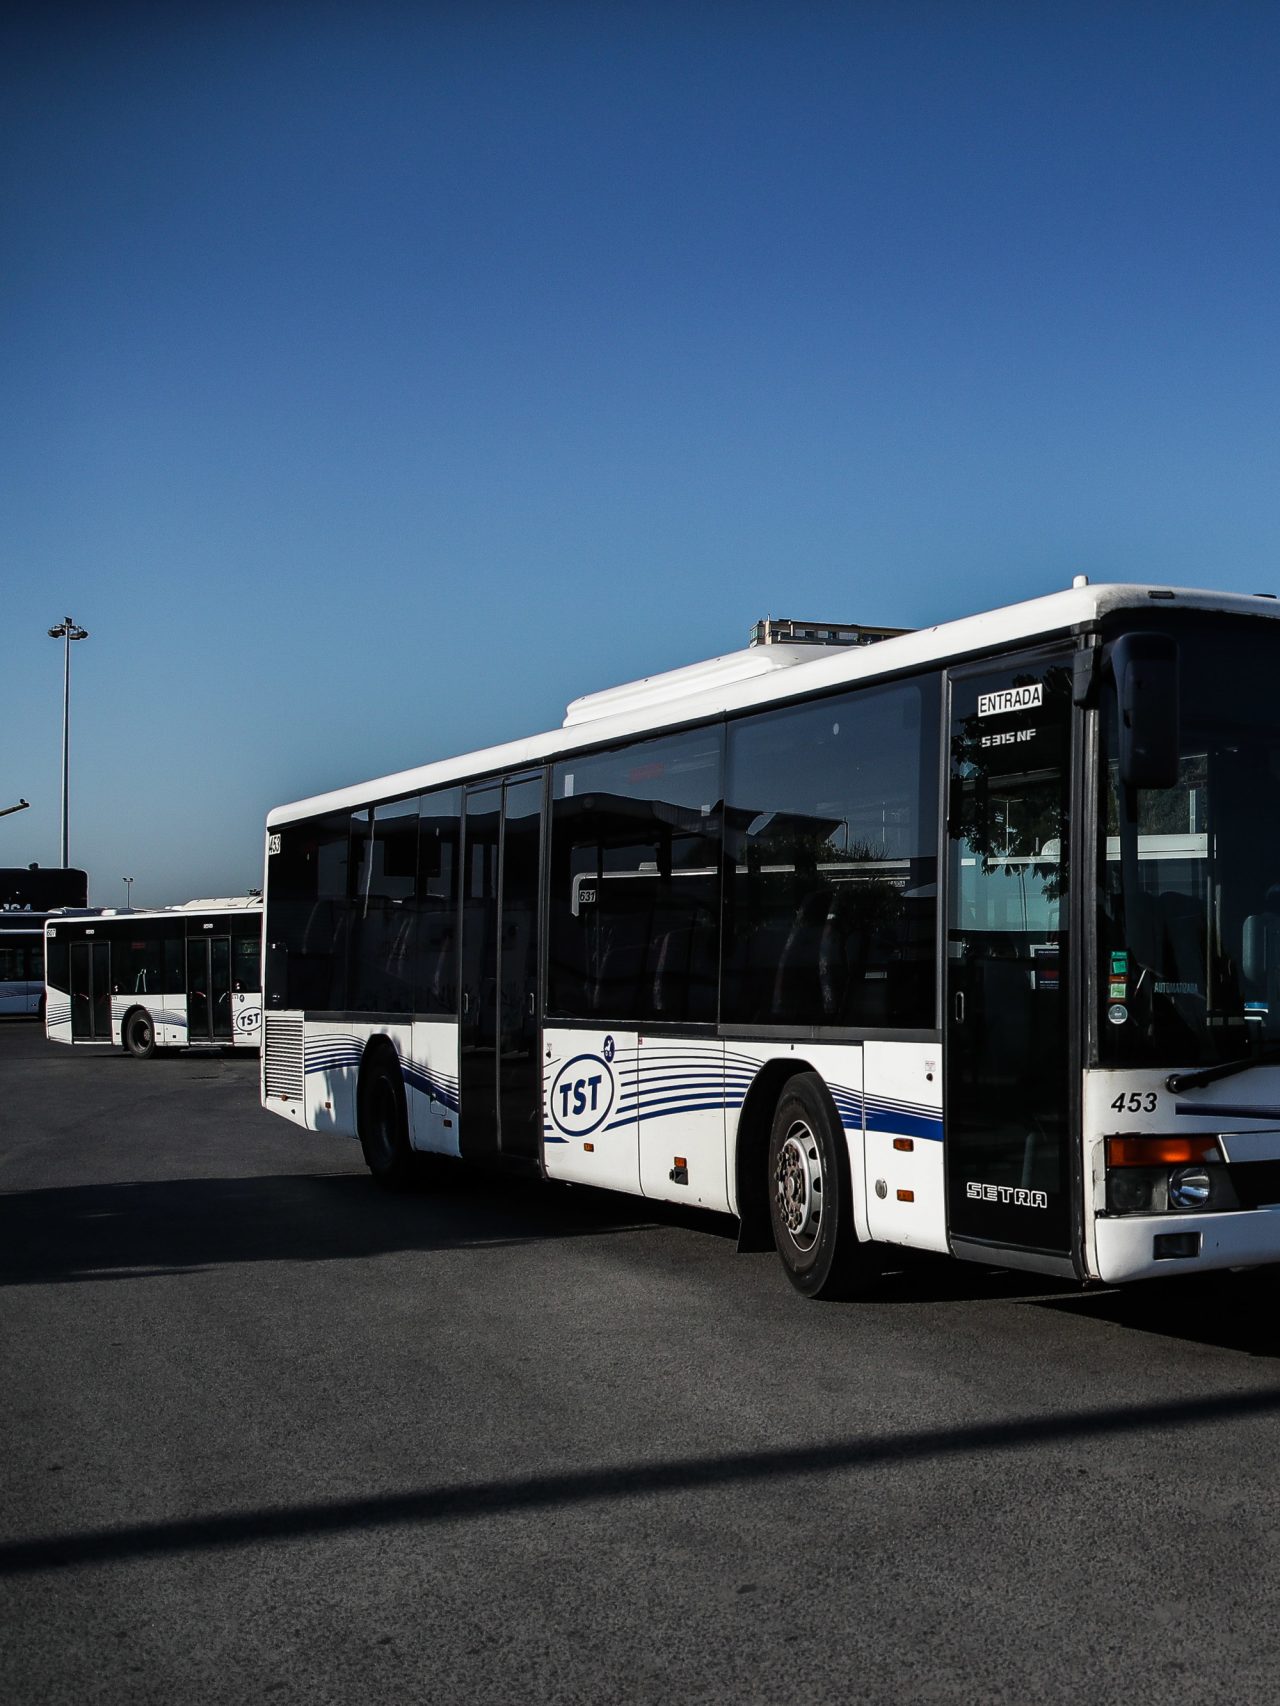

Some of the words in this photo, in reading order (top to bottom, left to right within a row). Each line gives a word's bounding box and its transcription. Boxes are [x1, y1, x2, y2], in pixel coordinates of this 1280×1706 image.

[980, 687, 1041, 713] ENTRADA
[580, 890, 596, 902] 631
[240, 1012, 261, 1027] TST
[559, 1074, 602, 1118] TST
[1110, 1092, 1158, 1113] 453
[966, 1181, 1048, 1209] SETRA
